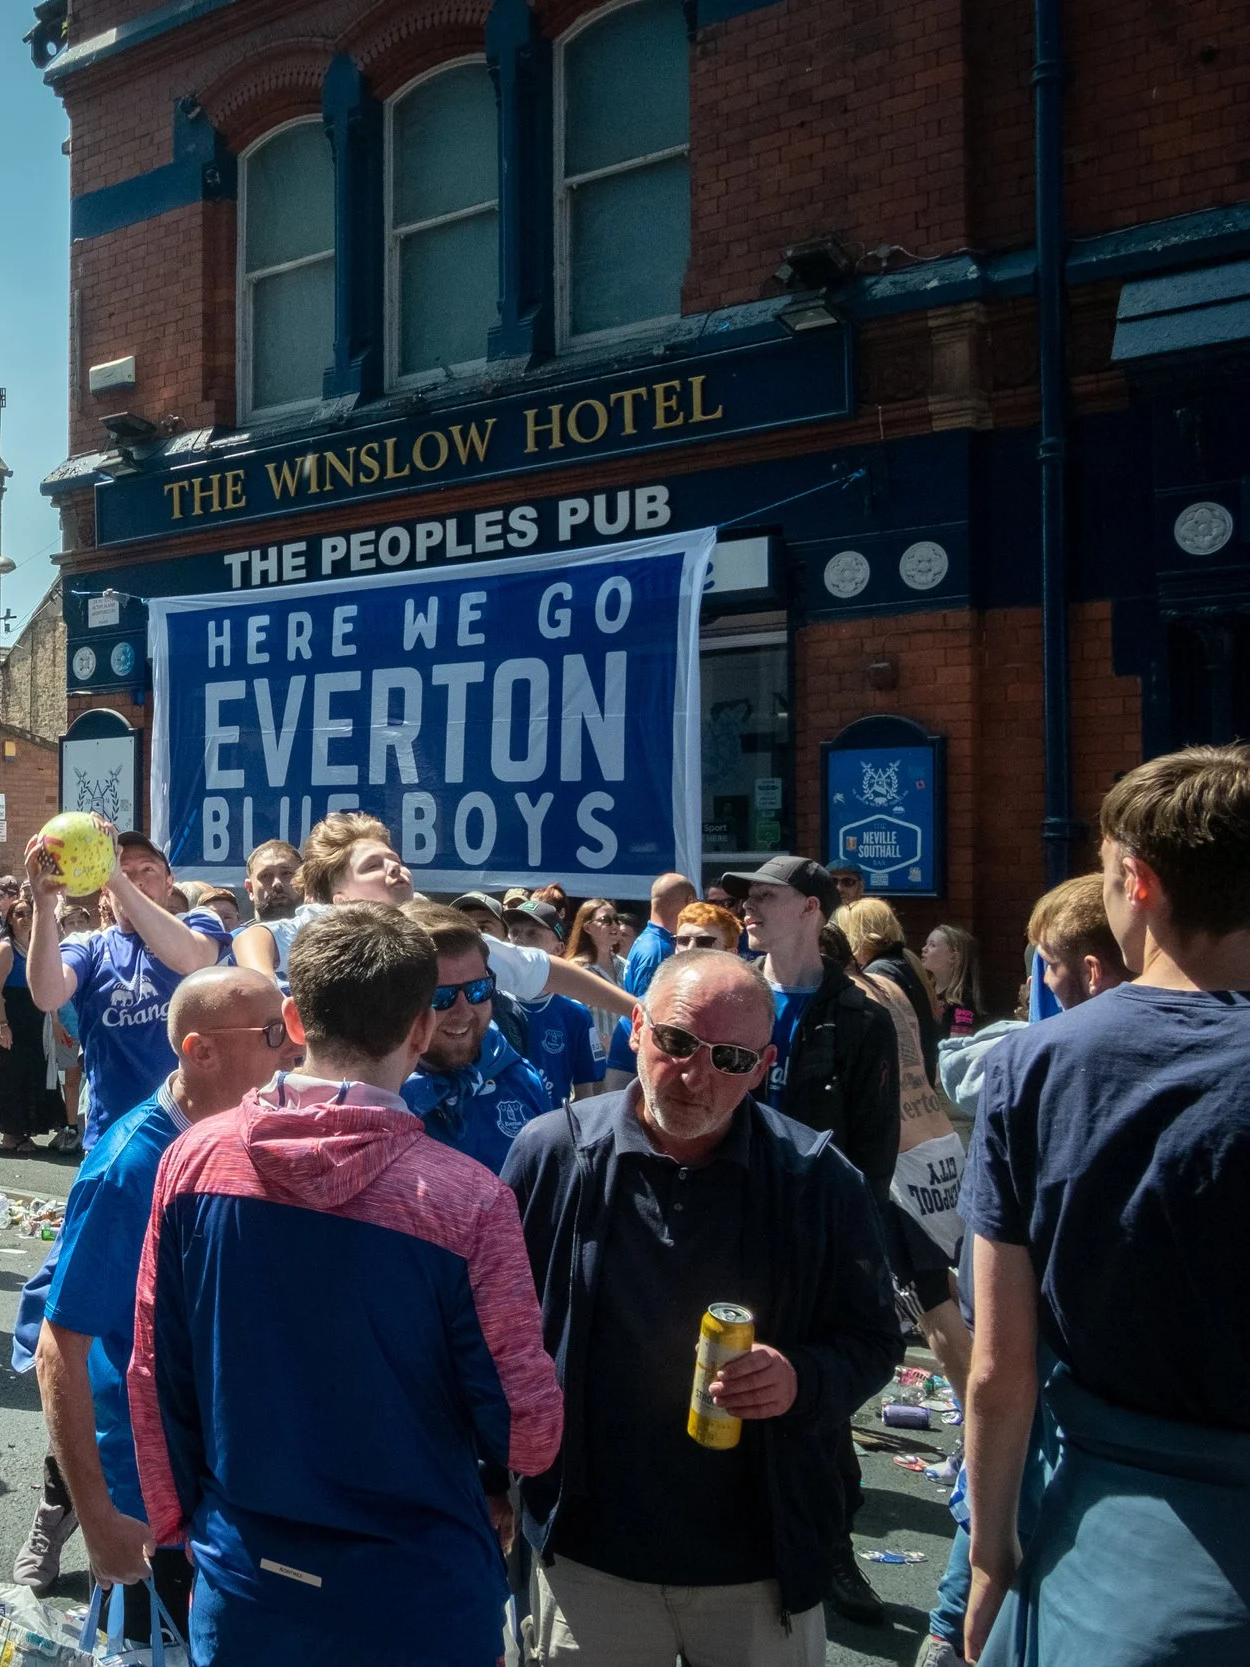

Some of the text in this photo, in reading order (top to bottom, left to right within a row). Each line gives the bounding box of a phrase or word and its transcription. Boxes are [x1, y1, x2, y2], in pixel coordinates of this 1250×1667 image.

[163, 375, 723, 519] THE WINSLOW HOTEL
[223, 485, 672, 589] THE PEOPLES PUB
[207, 604, 358, 669] HERE
[403, 590, 488, 651] WE
[537, 575, 632, 640] GO
[204, 651, 629, 790] EVERTON
[201, 790, 618, 870] BLU BOYS
[703, 824, 728, 832] Sport
[858, 845, 902, 858] SOUTHALL
[863, 831, 897, 844] NEVILLE
[926, 1156, 958, 1186] CITY
